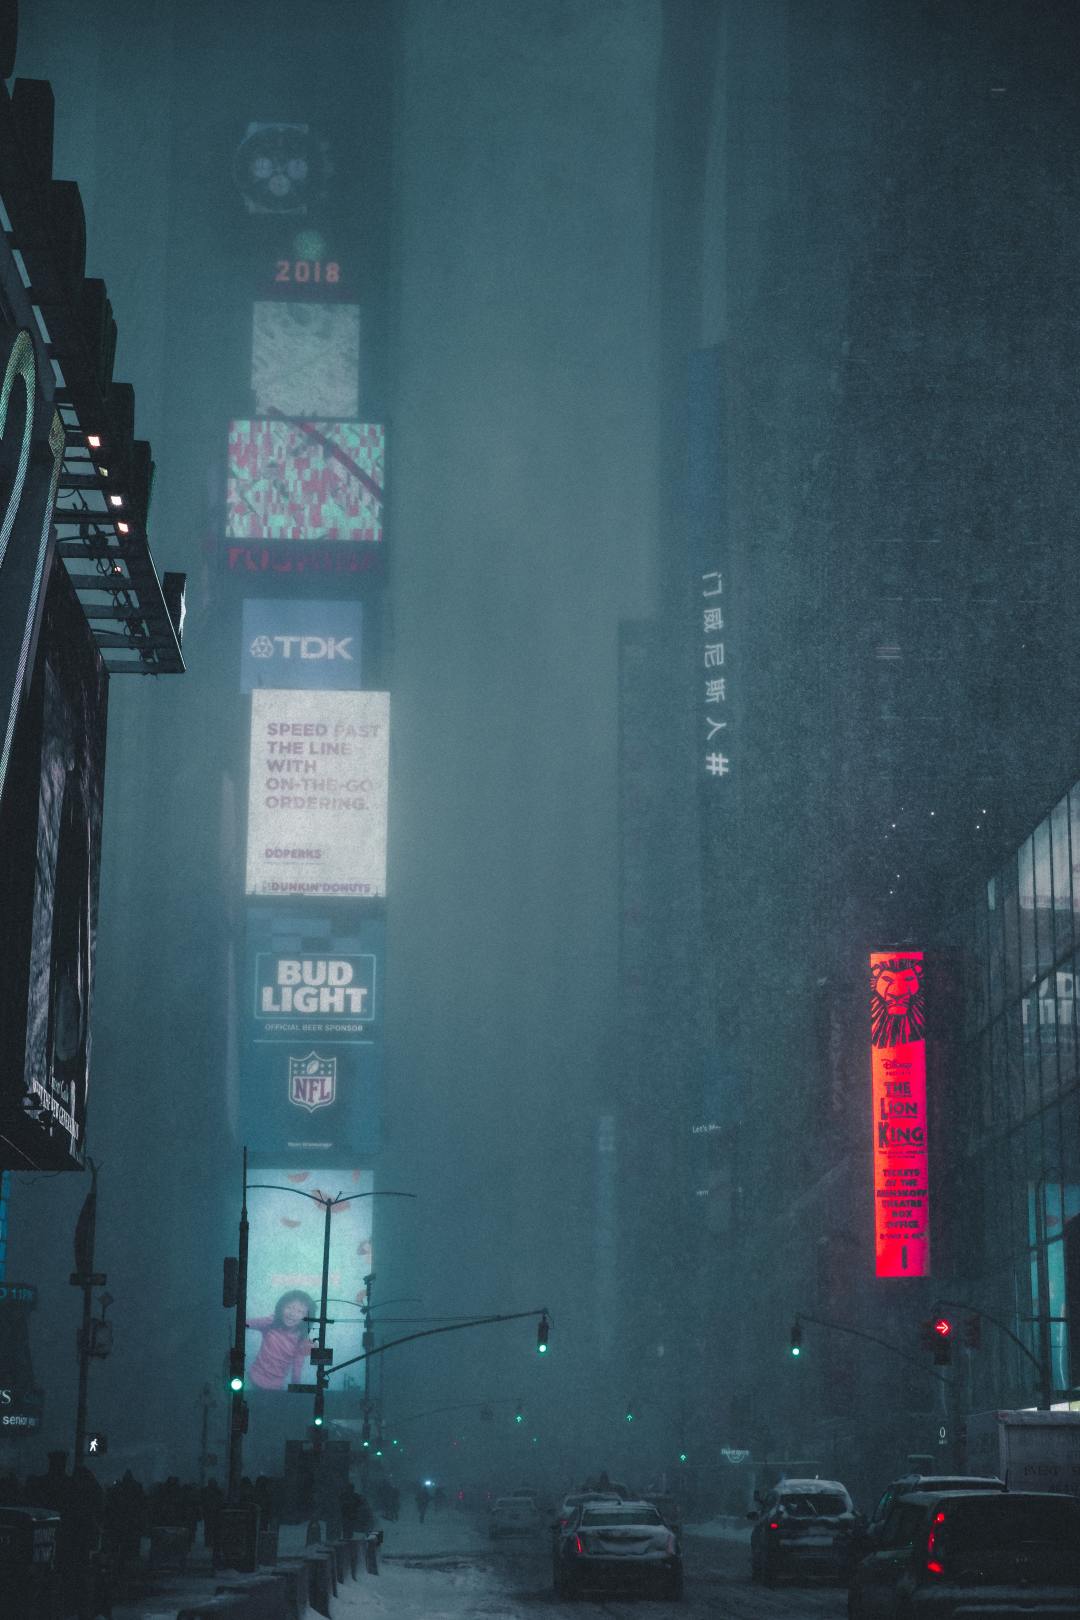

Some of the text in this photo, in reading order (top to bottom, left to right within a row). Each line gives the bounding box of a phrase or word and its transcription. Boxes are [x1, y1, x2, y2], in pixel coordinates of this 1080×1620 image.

[275, 261, 340, 283] 2018
[274, 636, 353, 660] TDK
[267, 722, 328, 737] SPEED
[267, 741, 353, 755] THE LINE
[266, 760, 317, 773] WITH
[266, 777, 373, 793] ON-THE-GO
[277, 960, 353, 986] BUD
[262, 986, 368, 1013] LIGHT
[265, 1023, 300, 1031] OFFICIAL
[324, 1024, 363, 1032] SPONSOR
[294, 1077, 330, 1103] NFL
[883, 1081, 911, 1096] THE
[878, 1121, 924, 1148] KING
